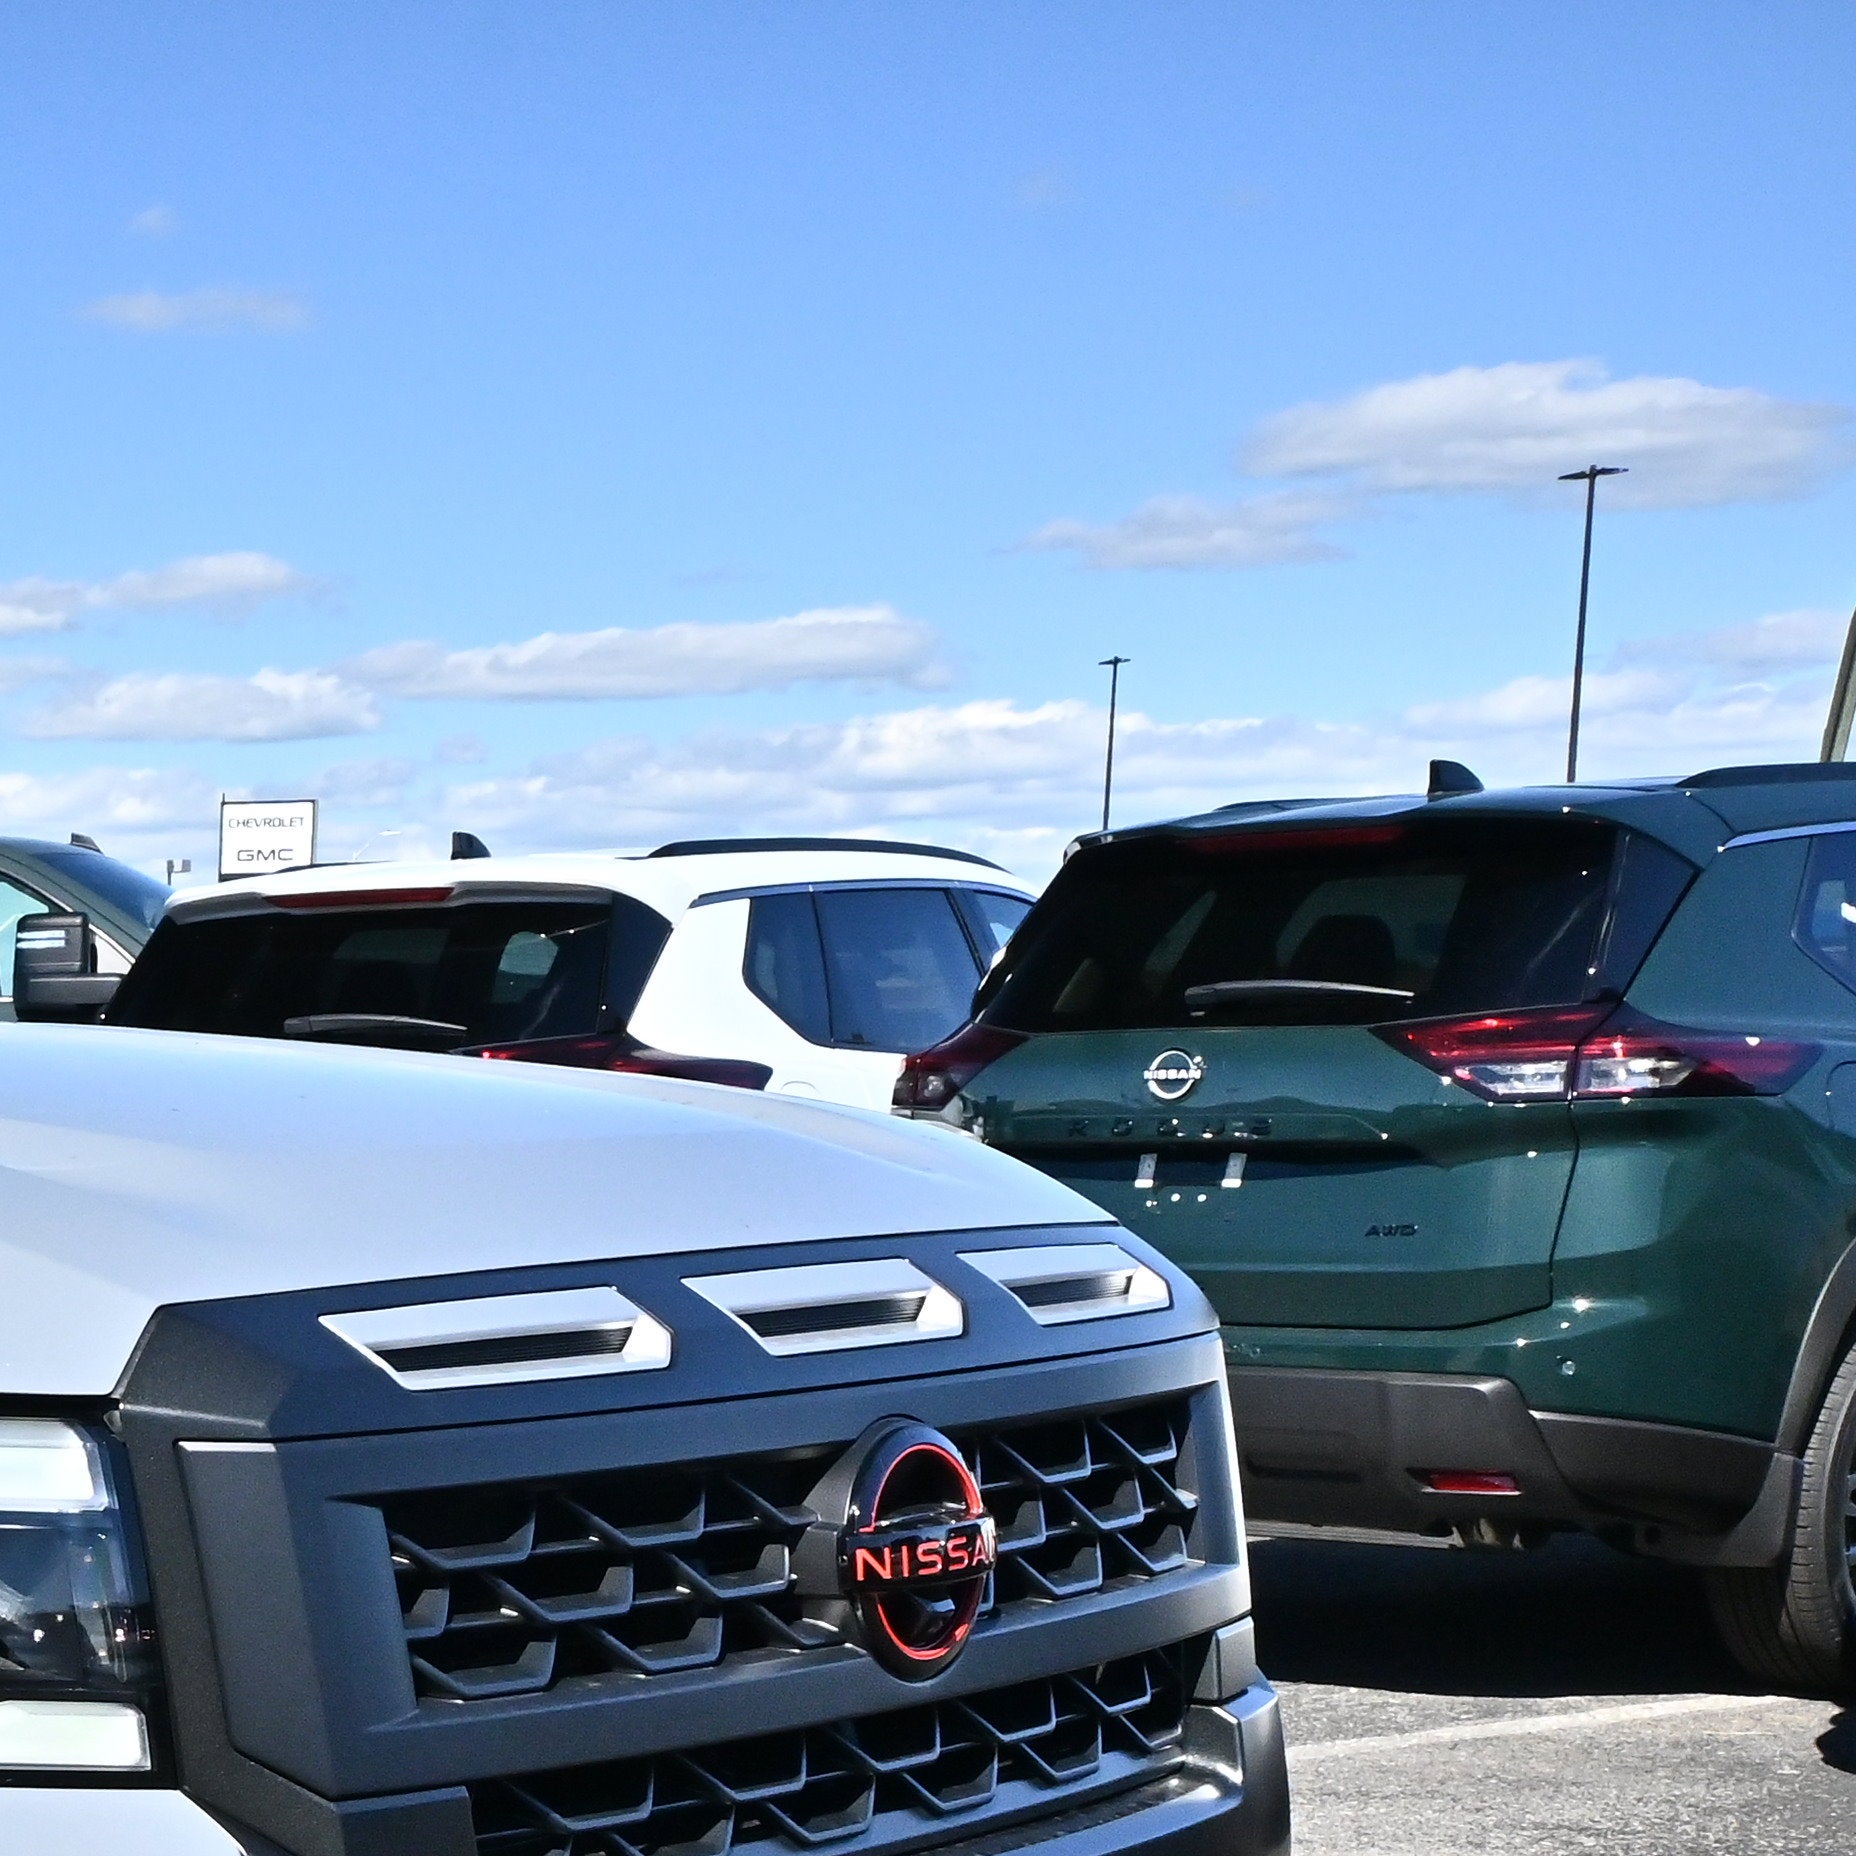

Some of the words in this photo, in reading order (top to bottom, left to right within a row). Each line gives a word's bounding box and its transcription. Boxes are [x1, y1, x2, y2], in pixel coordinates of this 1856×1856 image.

[228, 816, 305, 829] CHEVROLET
[237, 848, 294, 862] GMC
[1143, 1068, 1202, 1080] NISSAN
[1364, 1224, 1418, 1237] AWD
